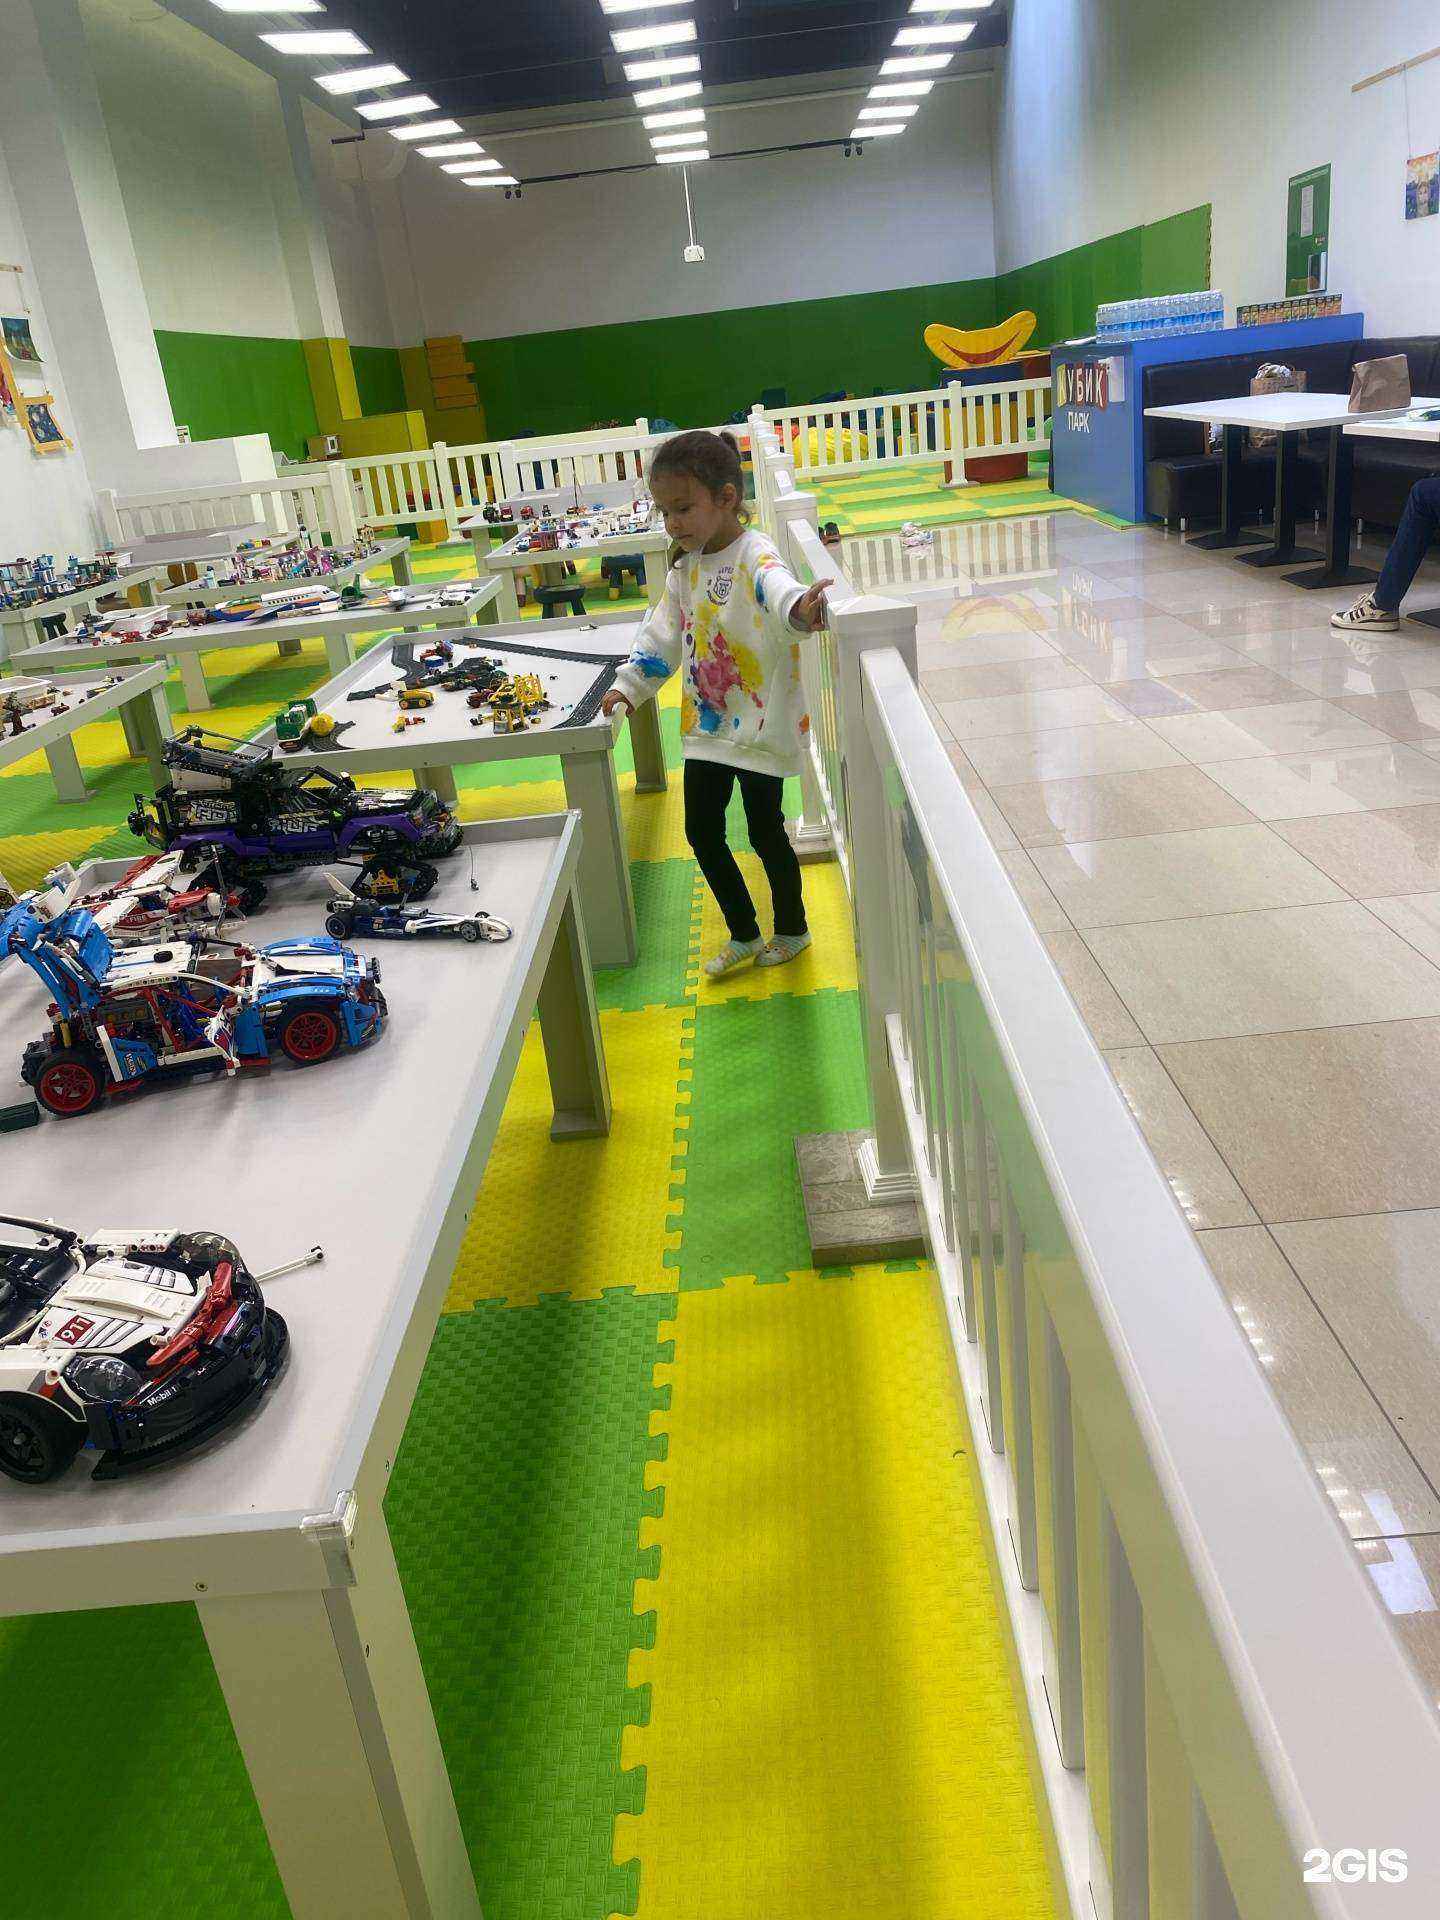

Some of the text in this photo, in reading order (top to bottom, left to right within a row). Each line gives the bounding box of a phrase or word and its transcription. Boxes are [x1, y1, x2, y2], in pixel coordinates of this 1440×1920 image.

[1067, 411, 1090, 433] ПАРК
[60, 1316, 92, 1341] 911
[147, 1388, 172, 1406] Mobil
